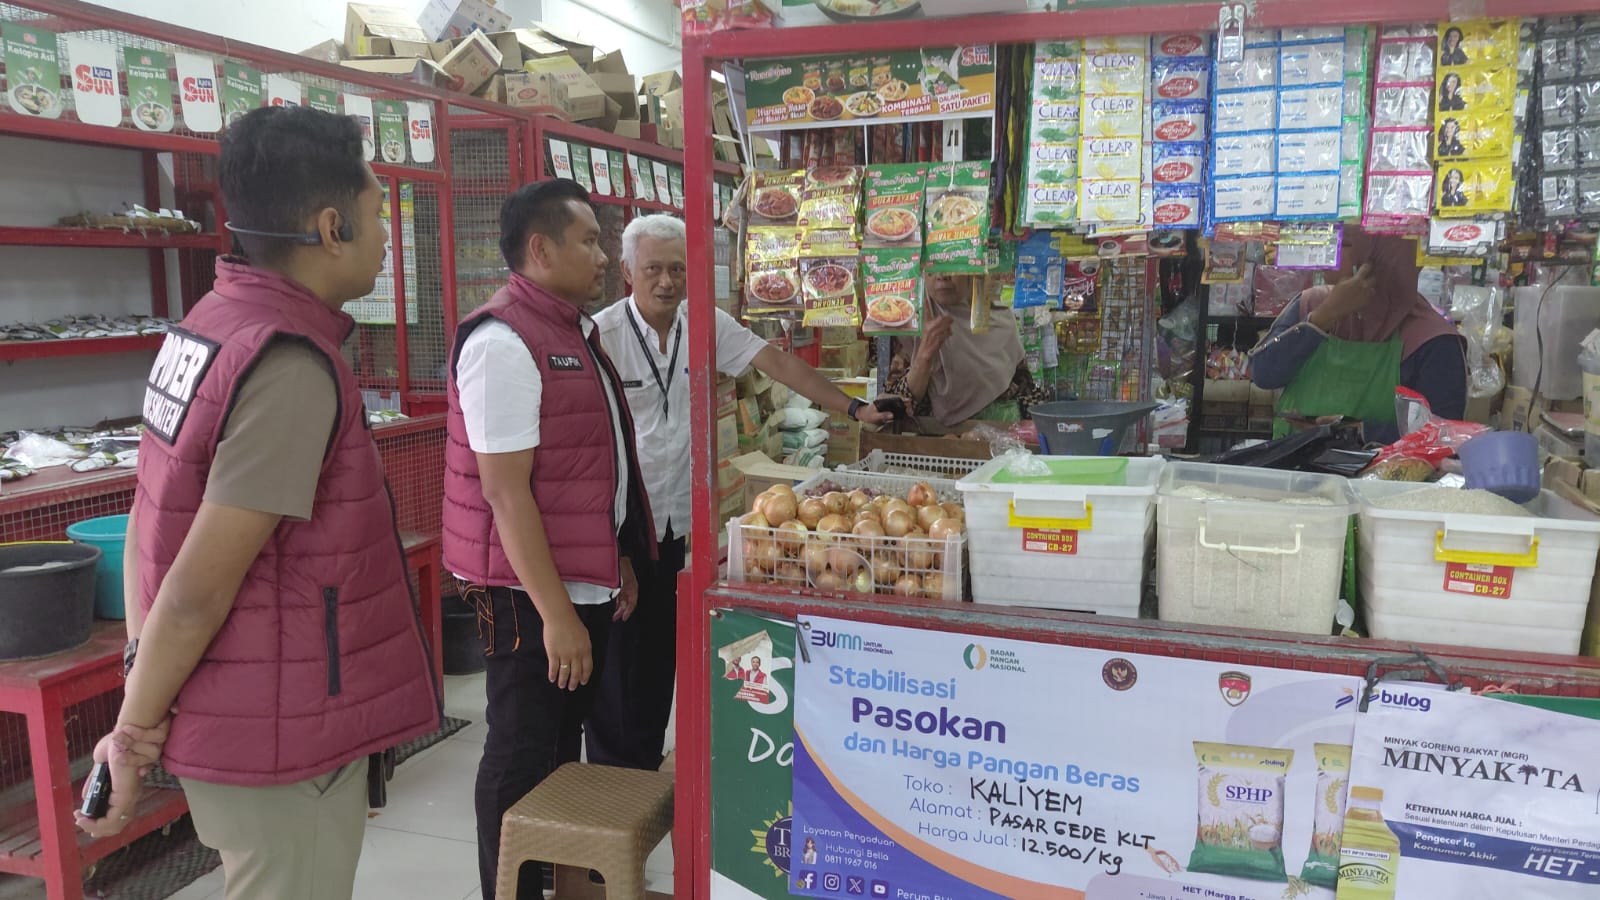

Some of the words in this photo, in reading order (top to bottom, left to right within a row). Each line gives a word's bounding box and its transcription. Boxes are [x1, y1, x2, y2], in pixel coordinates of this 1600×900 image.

[1092, 54, 1136, 69] CLEAR
[881, 95, 931, 113] KOMBINASI
[900, 103, 932, 116] TERBAIK
[1090, 96, 1134, 112] CLEAR
[1036, 146, 1078, 161] CLEAR
[1089, 139, 1133, 155] CLEAR
[1033, 188, 1077, 202] CLEAR
[1087, 182, 1132, 197] CLEAR
[551, 356, 581, 367] TAUFIK
[1048, 543, 1073, 552] CB-27
[1449, 570, 1491, 583] CONTAINER
[1493, 576, 1507, 585] BOX
[1475, 584, 1506, 596] CB-27
[990, 649, 1015, 657] BADAN
[990, 656, 1020, 665] PANGAN
[990, 663, 1026, 673] NASIONAL
[829, 665, 957, 700] Stabilisasi
[1381, 689, 1432, 712] bulog
[852, 697, 1006, 744] Pasokan
[1384, 736, 1418, 748] MINYAK
[1420, 741, 1461, 753] GORENG
[1463, 746, 1499, 757] RAKYAT
[1500, 751, 1529, 762] (MGR)
[843, 731, 887, 755] dan
[892, 738, 962, 769] Harga
[967, 750, 1059, 783] Pangan
[1066, 763, 1141, 793] Beras
[903, 774, 944, 794] Toko
[970, 776, 1083, 817] KALIYEM
[1225, 785, 1273, 802] SPHP
[909, 797, 973, 820] Alamat
[1405, 802, 1458, 818] KETENTUAN
[1460, 811, 1493, 823] HARGA
[1494, 815, 1518, 827] JUAL
[918, 821, 969, 842] Harga
[973, 830, 1009, 847] Jual
[989, 806, 1049, 836] PASAR
[1054, 820, 1108, 844] GEDE
[1117, 829, 1156, 850] KLT
[1404, 812, 1431, 823] Sesuai
[1432, 818, 1469, 830] ketentuan
[1470, 823, 1495, 833] dalam
[1496, 827, 1538, 840] Keputusan
[1539, 833, 1571, 845] Menteri
[803, 825, 842, 839] Layanan
[844, 829, 896, 849] Pengaduan
[1415, 831, 1462, 846] Pengecer
[1463, 837, 1477, 849] ke
[825, 843, 865, 858] Hubungi
[1413, 842, 1467, 857] Konsumen
[1468, 851, 1498, 862] Akhir
[824, 854, 843, 865] 0811
[844, 857, 862, 868] 1967
[864, 859, 878, 871] 016
[1523, 853, 1585, 877] HET
[897, 887, 931, 900] Perum
[1183, 885, 1202, 895] HET
